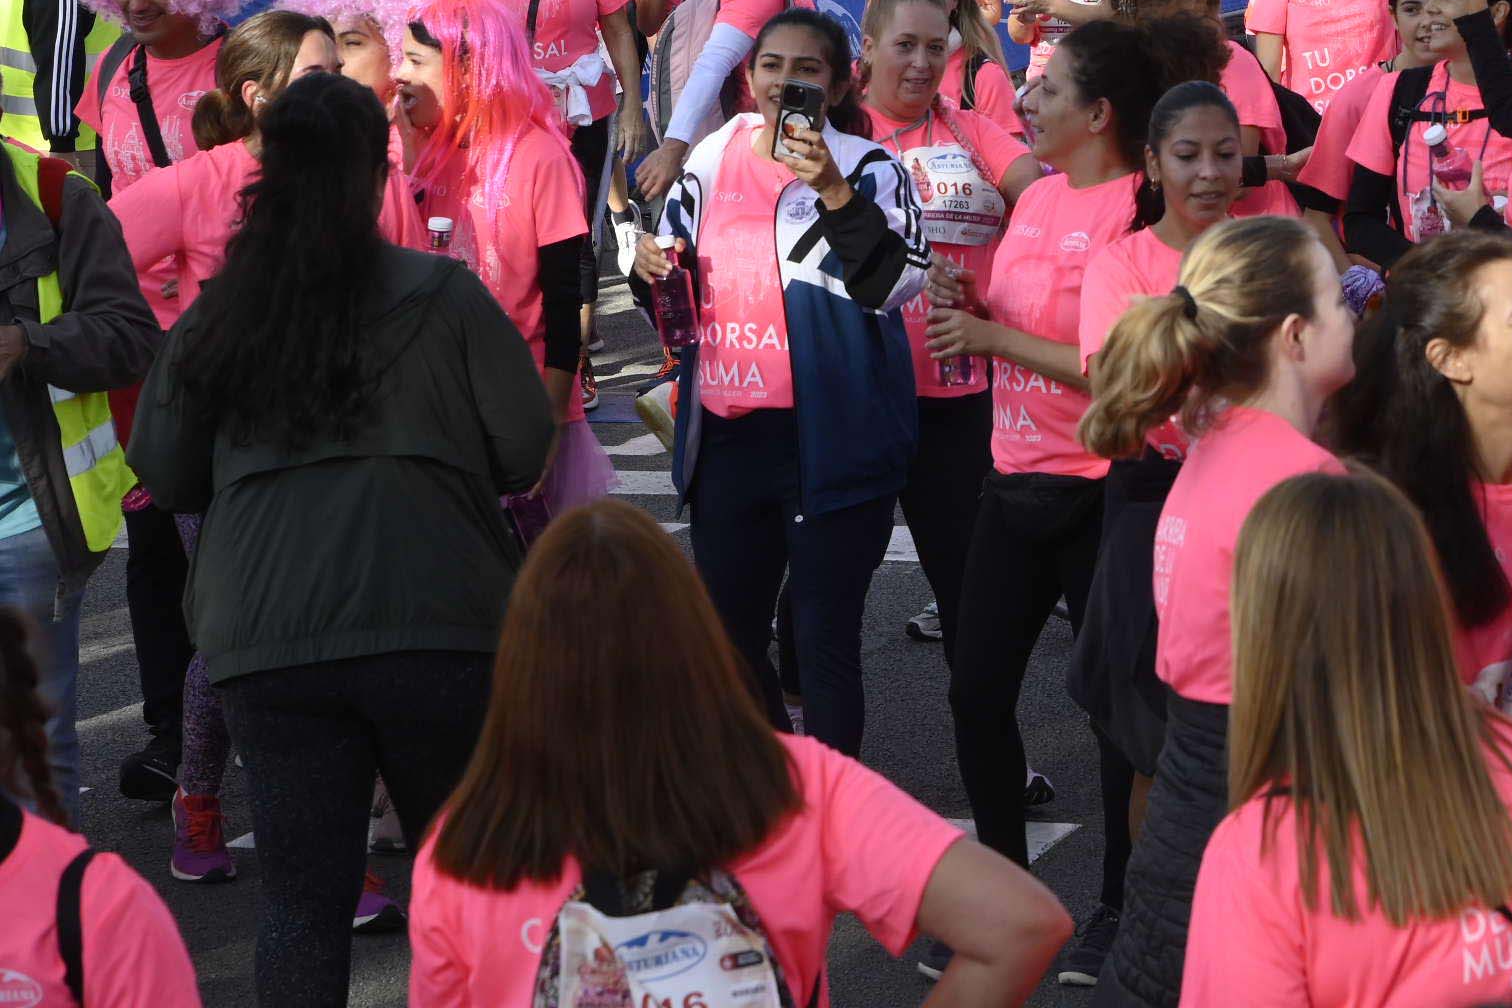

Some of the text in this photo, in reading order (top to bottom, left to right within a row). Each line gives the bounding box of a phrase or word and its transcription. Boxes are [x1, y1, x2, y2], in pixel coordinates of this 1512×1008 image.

[1302, 47, 1332, 70] TU
[936, 182, 973, 196] 016
[942, 199, 970, 210] 17263
